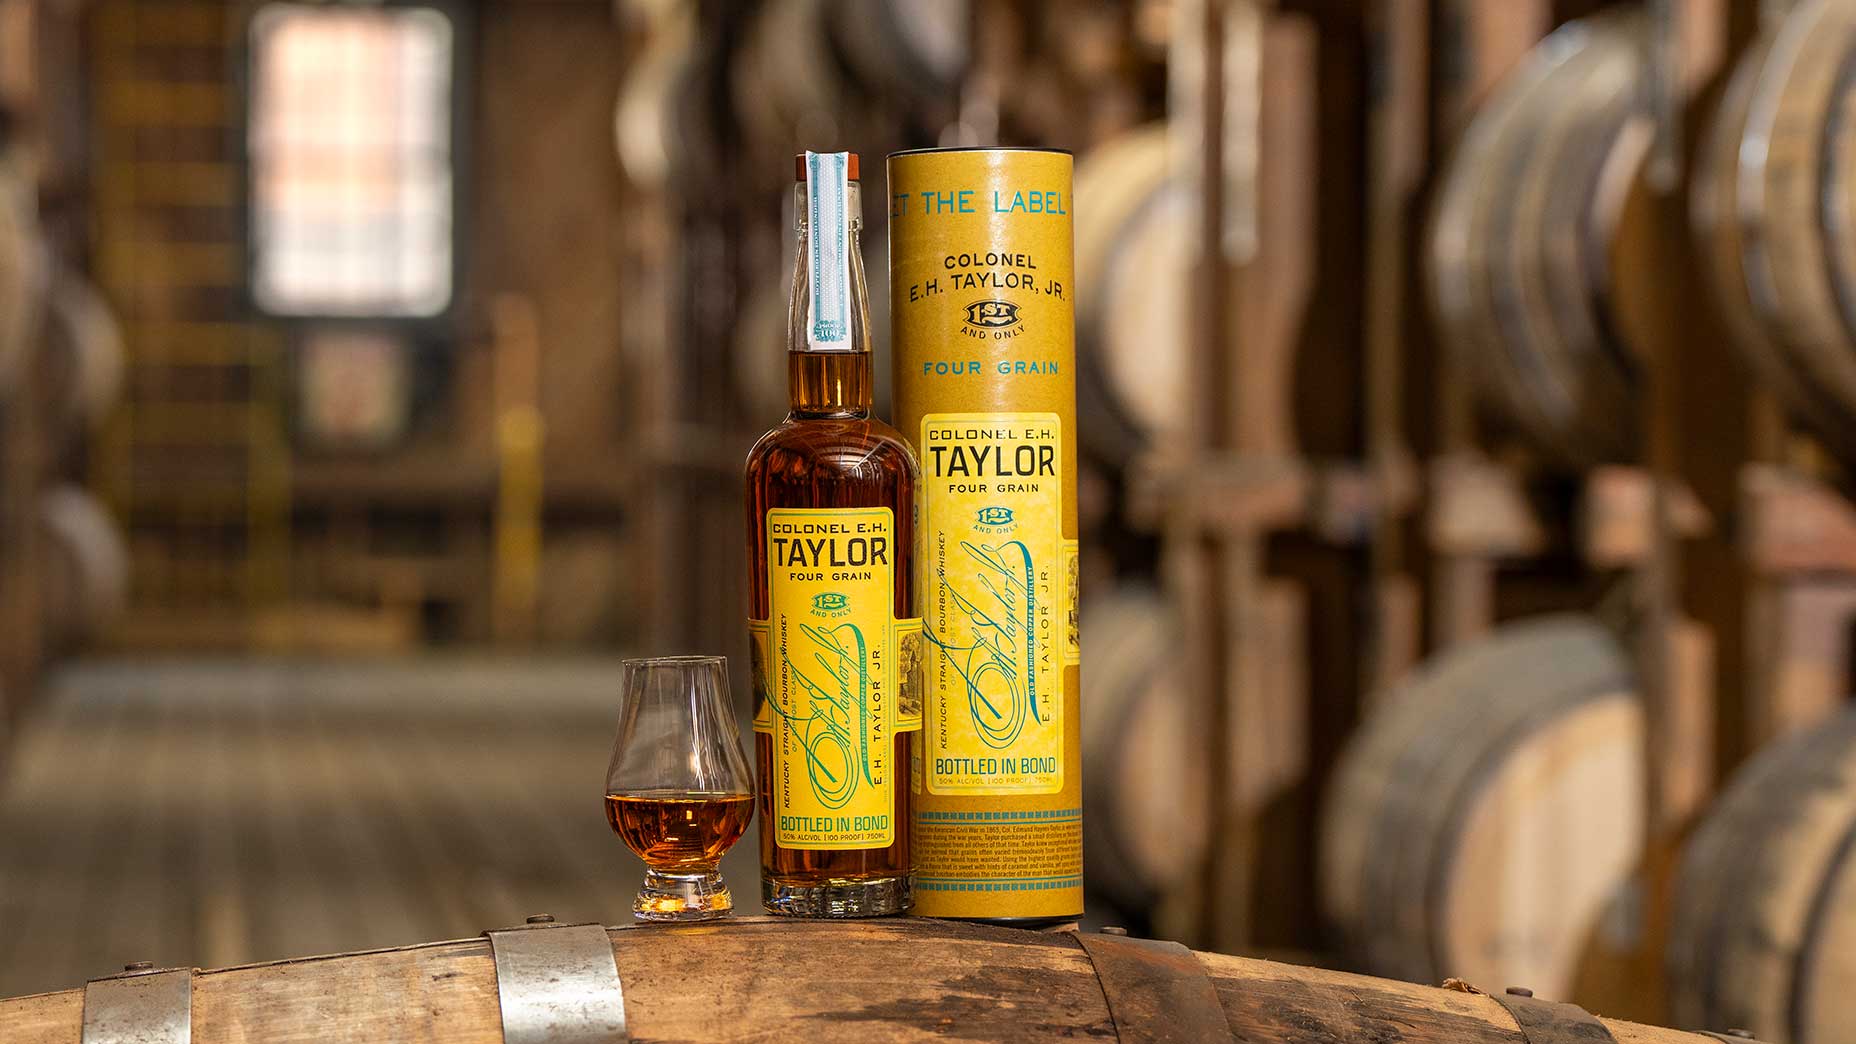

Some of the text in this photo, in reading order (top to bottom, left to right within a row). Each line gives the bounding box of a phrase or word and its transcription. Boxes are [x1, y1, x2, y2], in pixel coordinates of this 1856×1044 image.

[921, 191, 975, 214] THE
[994, 190, 1066, 215] LABEL
[944, 253, 1036, 269] COLONEL
[910, 272, 1065, 302] E.H. TAYLOR, JR.
[970, 303, 1011, 324] 1ST
[960, 325, 1025, 340] AND ONLY
[923, 361, 1059, 376] FOUR GRAIN
[930, 429, 1055, 440] COLONEL E.H.
[930, 445, 1055, 477] TAYLOR
[949, 484, 1039, 493] FOUR GRAIN
[773, 523, 887, 533] COLONEL E.H.
[973, 523, 1019, 534] AND ONLY
[773, 537, 888, 567] TAYLOR
[790, 572, 871, 581] FOUR GRAIN
[810, 608, 851, 617] AND ONLY
[938, 583, 946, 633] BOURBON
[1040, 565, 1050, 722] E.H. TAYLOR JR.
[872, 644, 882, 785] E.H. TAYLOR JR.
[936, 759, 997, 775] BOTTLED
[1001, 758, 1016, 774] IN
[1021, 757, 1056, 774] BOND
[781, 815, 888, 832] BOTTLED IN BOND
